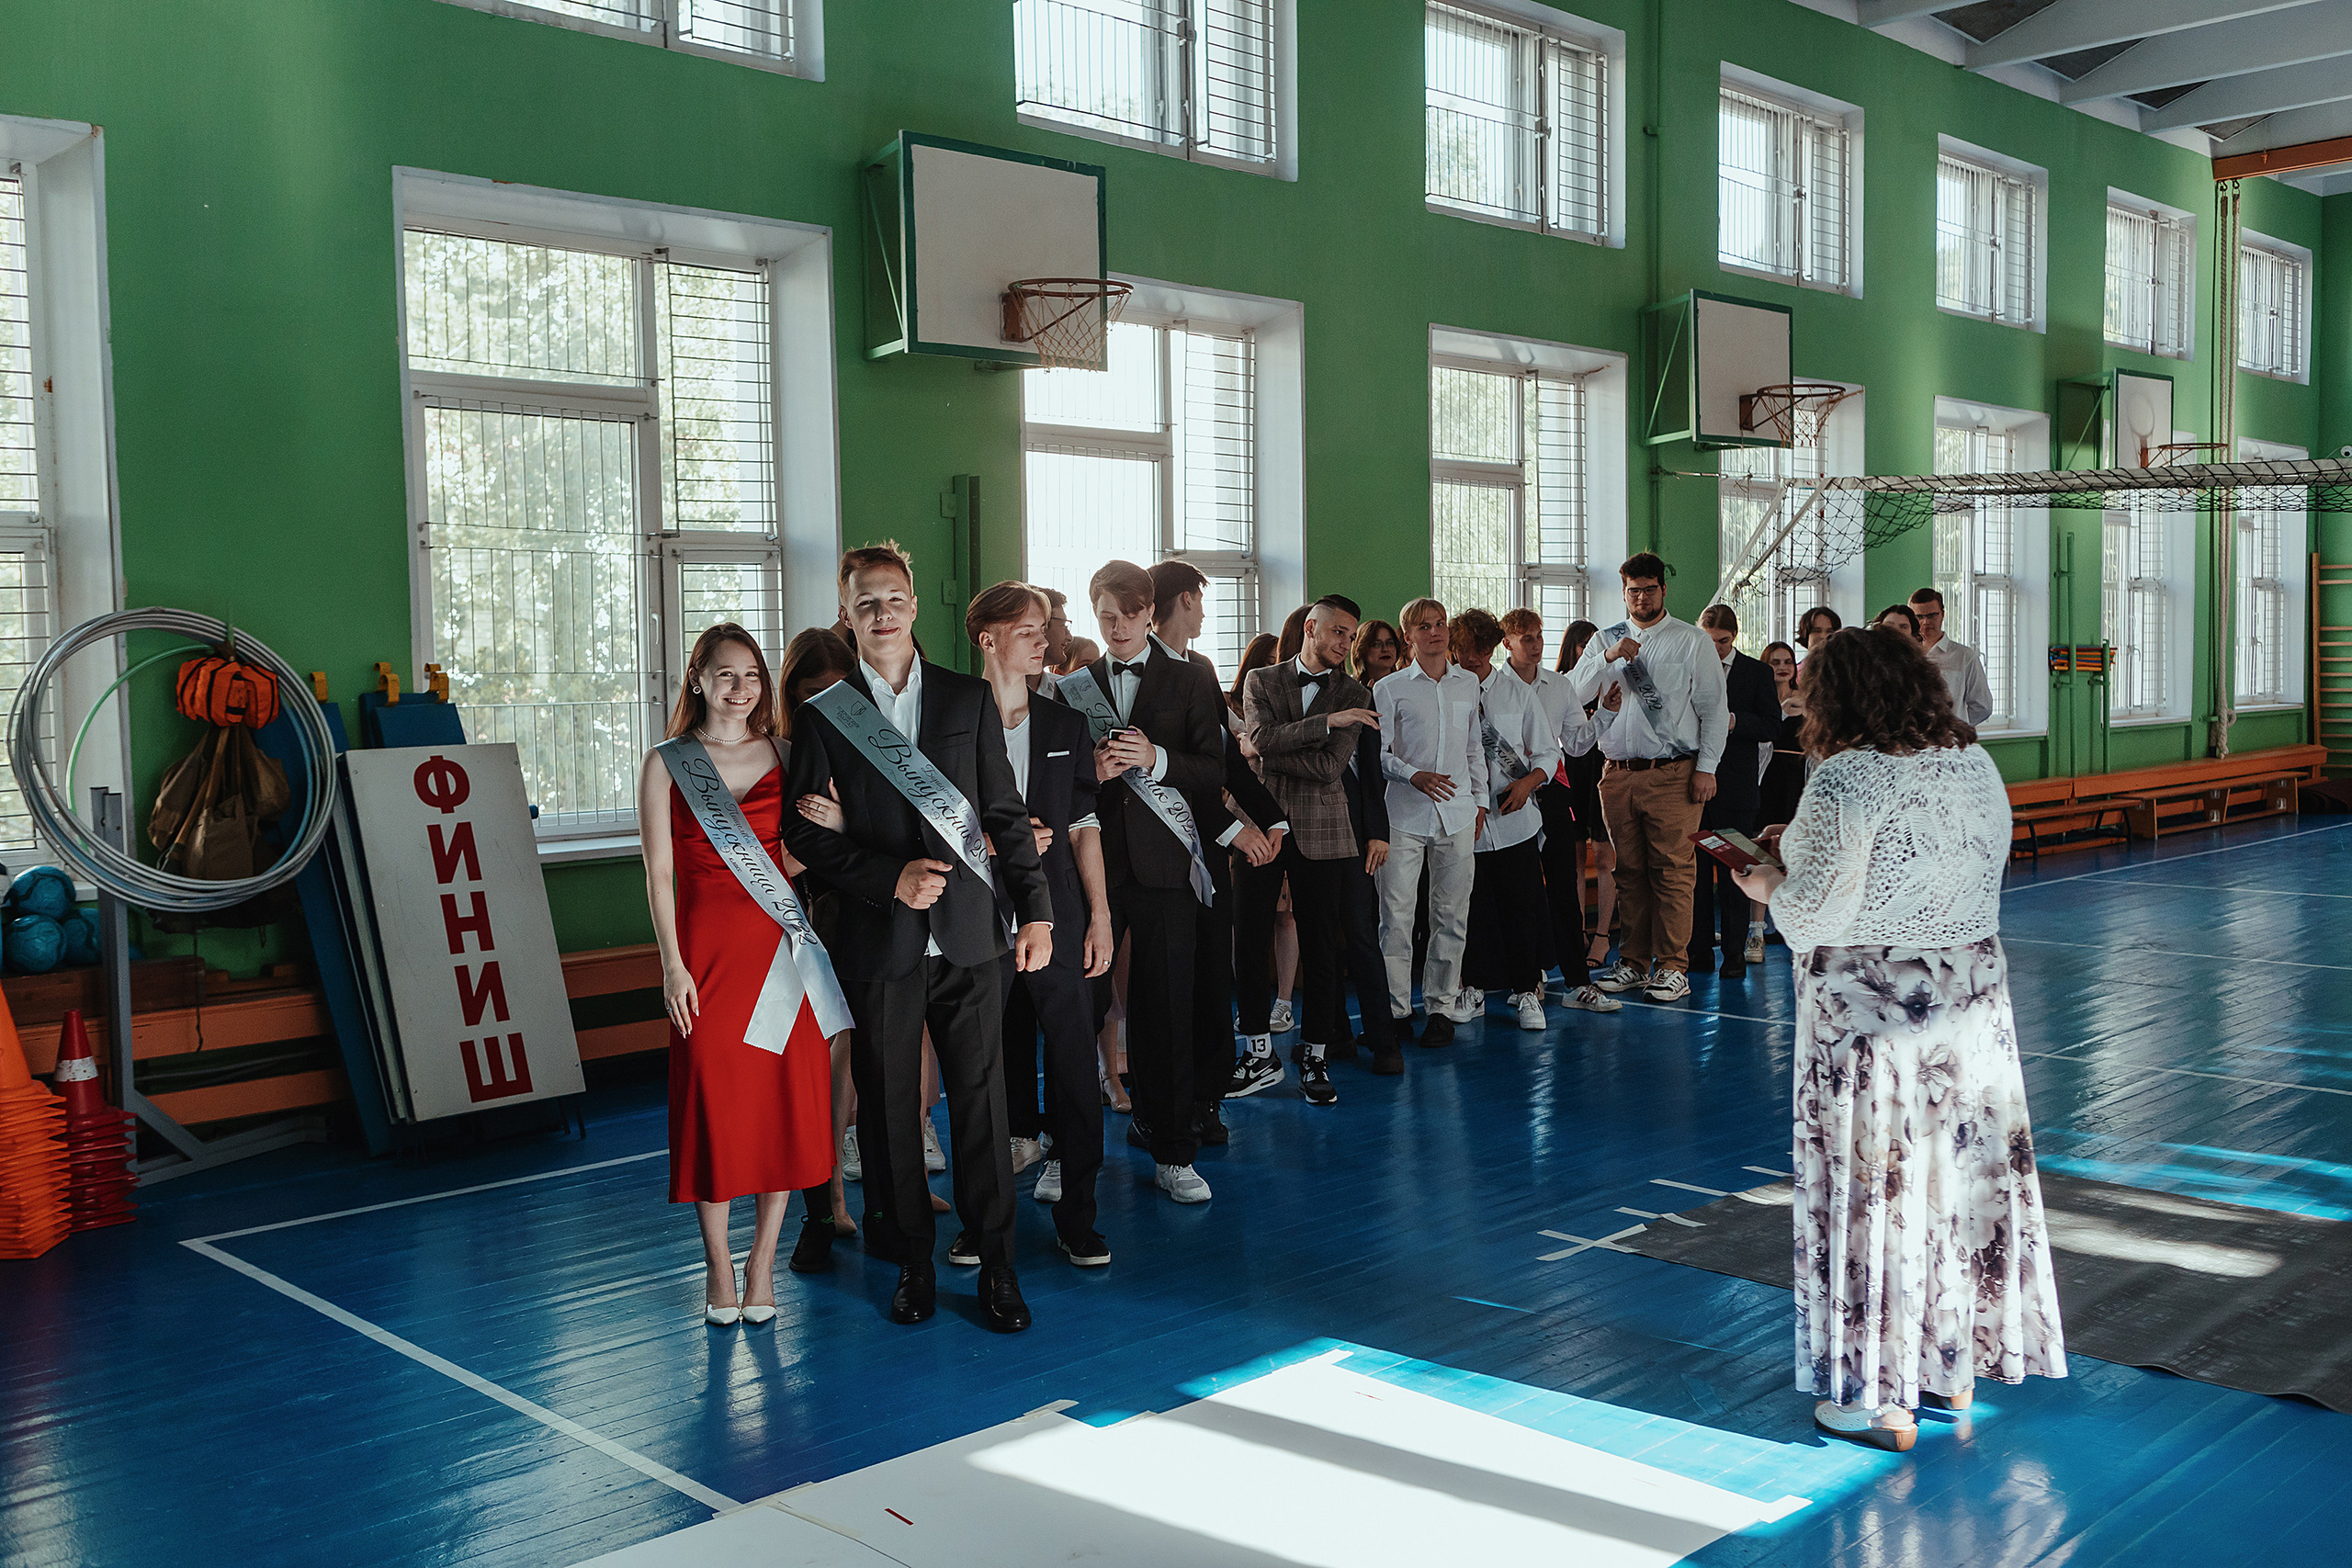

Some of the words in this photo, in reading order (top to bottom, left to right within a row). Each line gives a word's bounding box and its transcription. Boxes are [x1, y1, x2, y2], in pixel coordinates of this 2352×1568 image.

[1639, 684, 1662, 710] 2022
[867, 728, 973, 845] Выпускник
[682, 758, 776, 896] Выпускница
[772, 897, 818, 945] 2022
[413, 755, 533, 1103] ФИНИШ
[1251, 1038, 1266, 1053] 13
